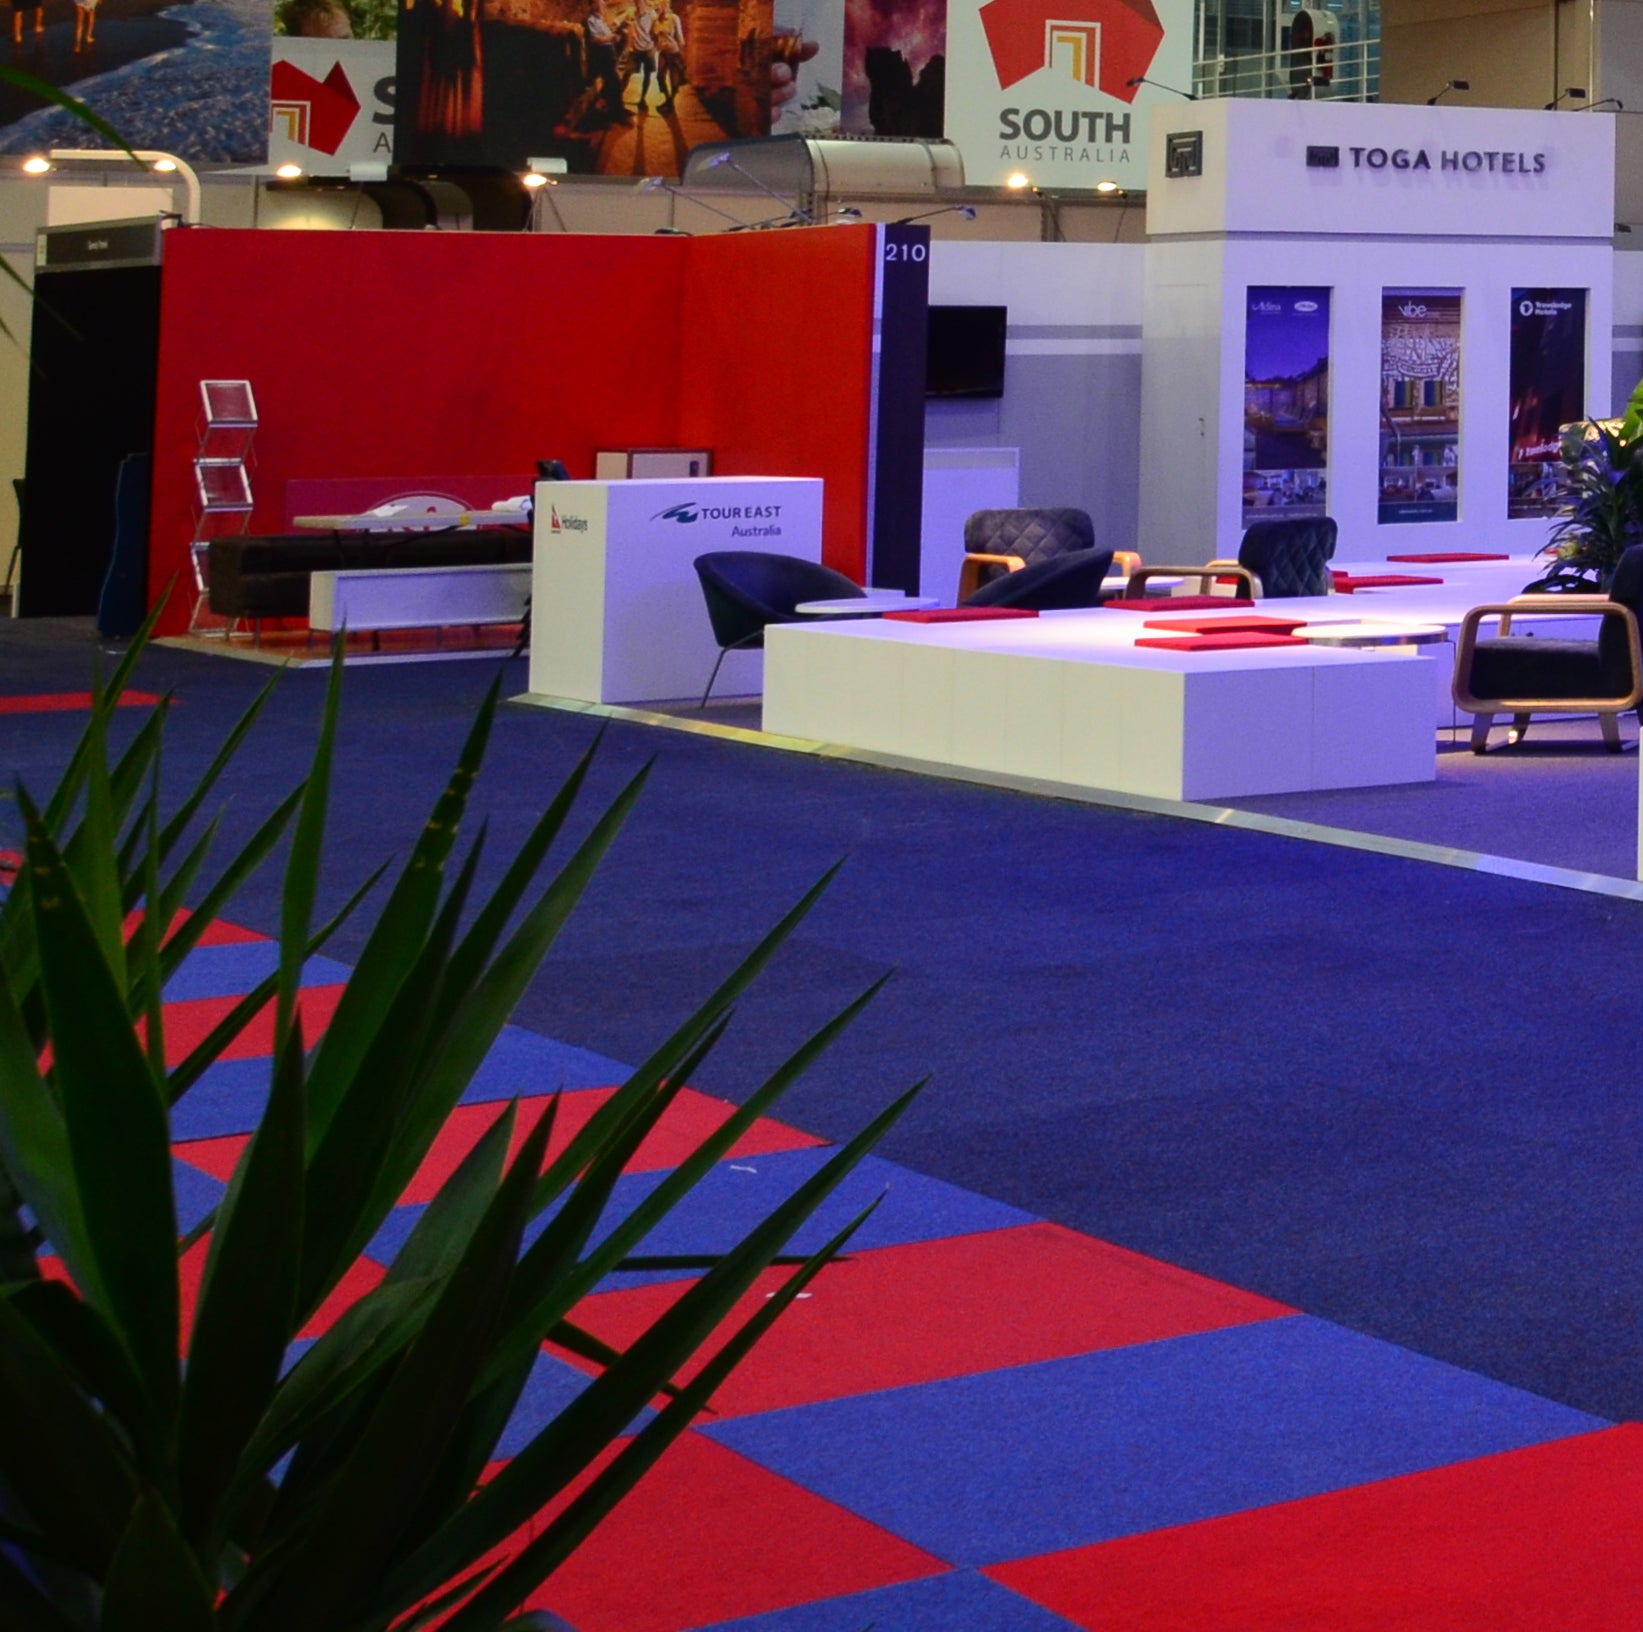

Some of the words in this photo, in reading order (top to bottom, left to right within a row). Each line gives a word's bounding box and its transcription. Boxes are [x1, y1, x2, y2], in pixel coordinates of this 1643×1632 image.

[999, 108, 1131, 144] SOUTH
[1000, 145, 1131, 163] AUSTRALIA
[1349, 147, 1431, 170] TOGA
[1441, 150, 1546, 174] HOTELS
[886, 243, 926, 262] 210
[1398, 299, 1427, 318] vibe
[701, 507, 741, 521] TOUR
[745, 505, 782, 519] EAST
[731, 525, 782, 537] Australia
